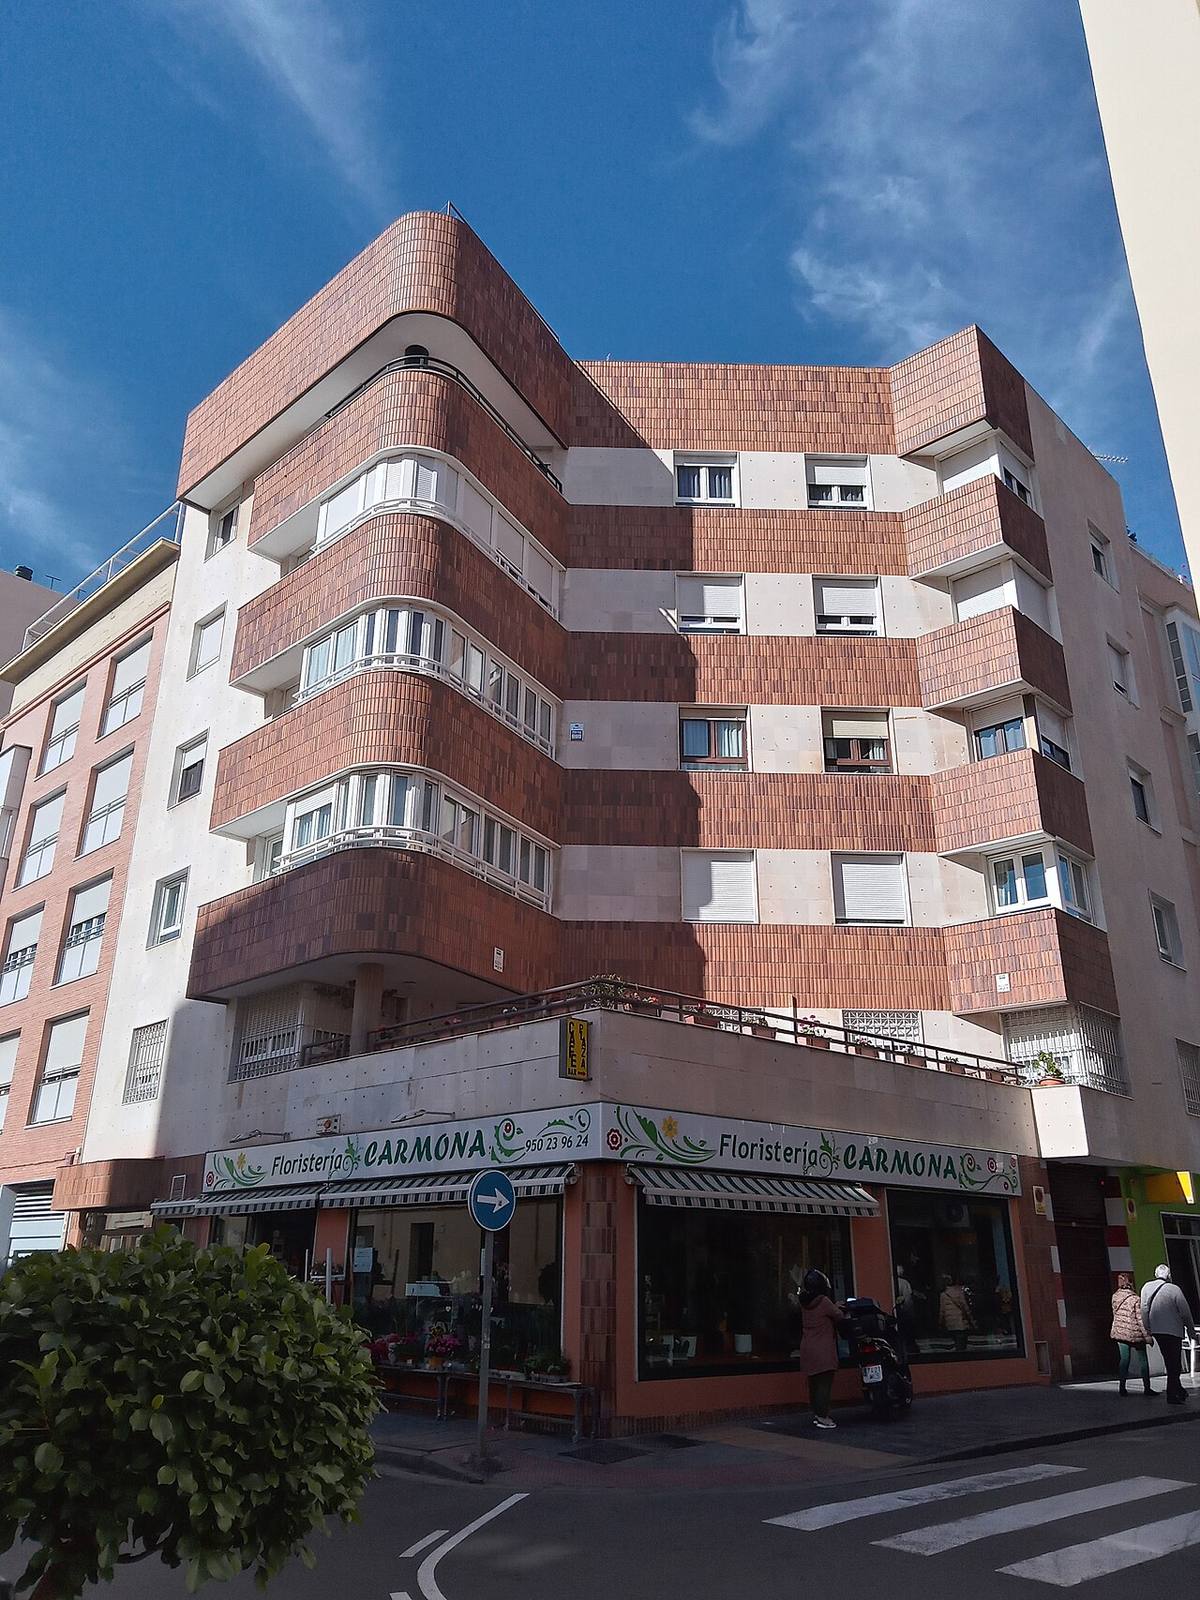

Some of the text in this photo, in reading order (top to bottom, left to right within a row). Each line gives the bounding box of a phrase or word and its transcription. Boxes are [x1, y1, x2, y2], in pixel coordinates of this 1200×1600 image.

[578, 1023, 586, 1069] PLAZA
[271, 1129, 486, 1177] Floristería CARMONA
[525, 1134, 589, 1153] 950 23 96 24
[719, 1133, 958, 1180] Floristería CARMONA
